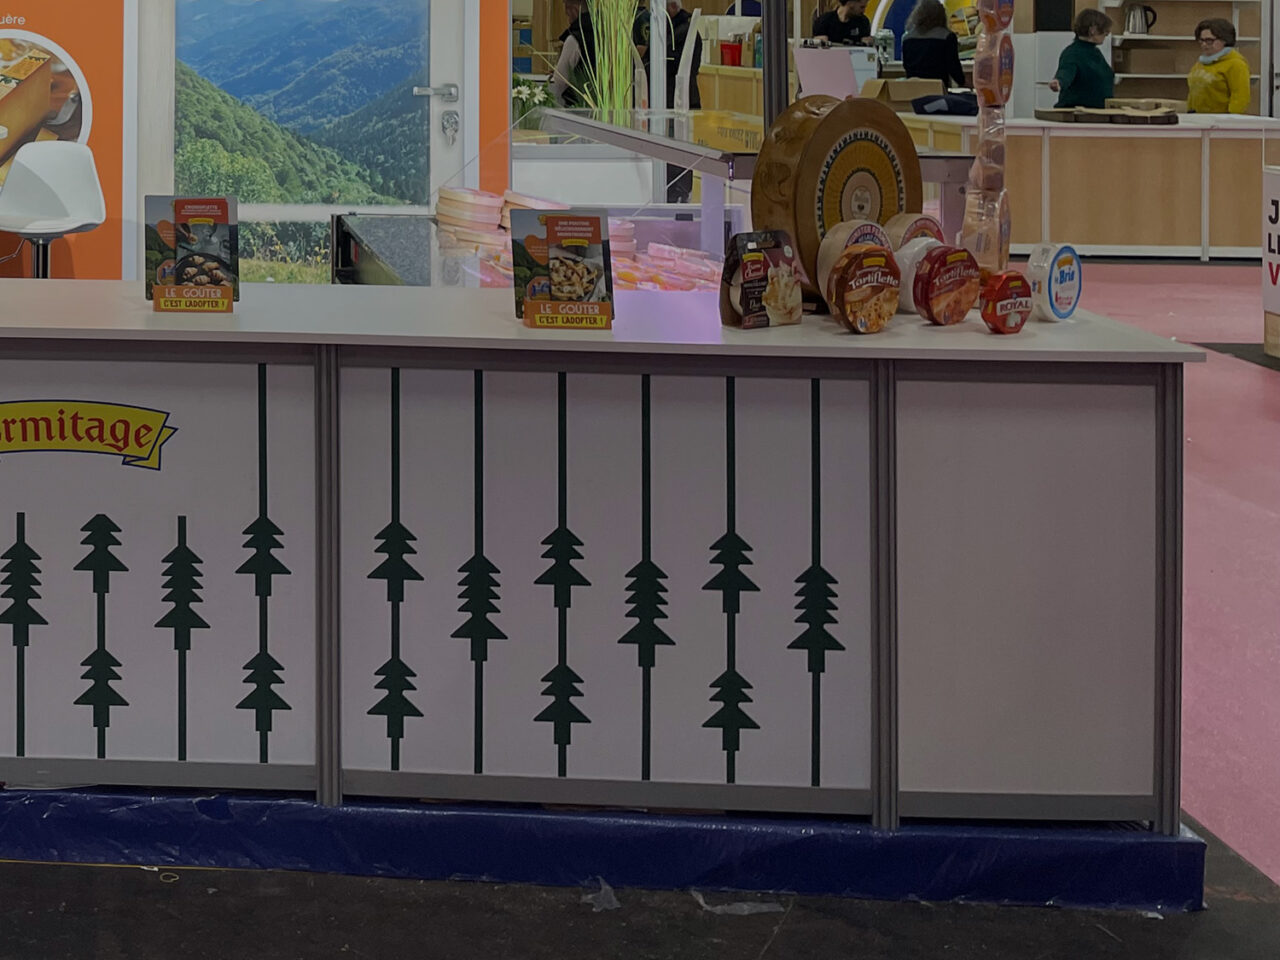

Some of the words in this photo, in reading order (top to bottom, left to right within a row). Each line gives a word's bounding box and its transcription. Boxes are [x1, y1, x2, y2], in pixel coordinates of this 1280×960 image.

[848, 271, 899, 290] Tartiflette
[933, 265, 980, 287] Tartiflette
[165, 288, 177, 298] LE
[163, 299, 182, 308] C'EST
[540, 303, 552, 314] LE
[999, 300, 1030, 314] ROYAL
[539, 315, 558, 324] C'EST
